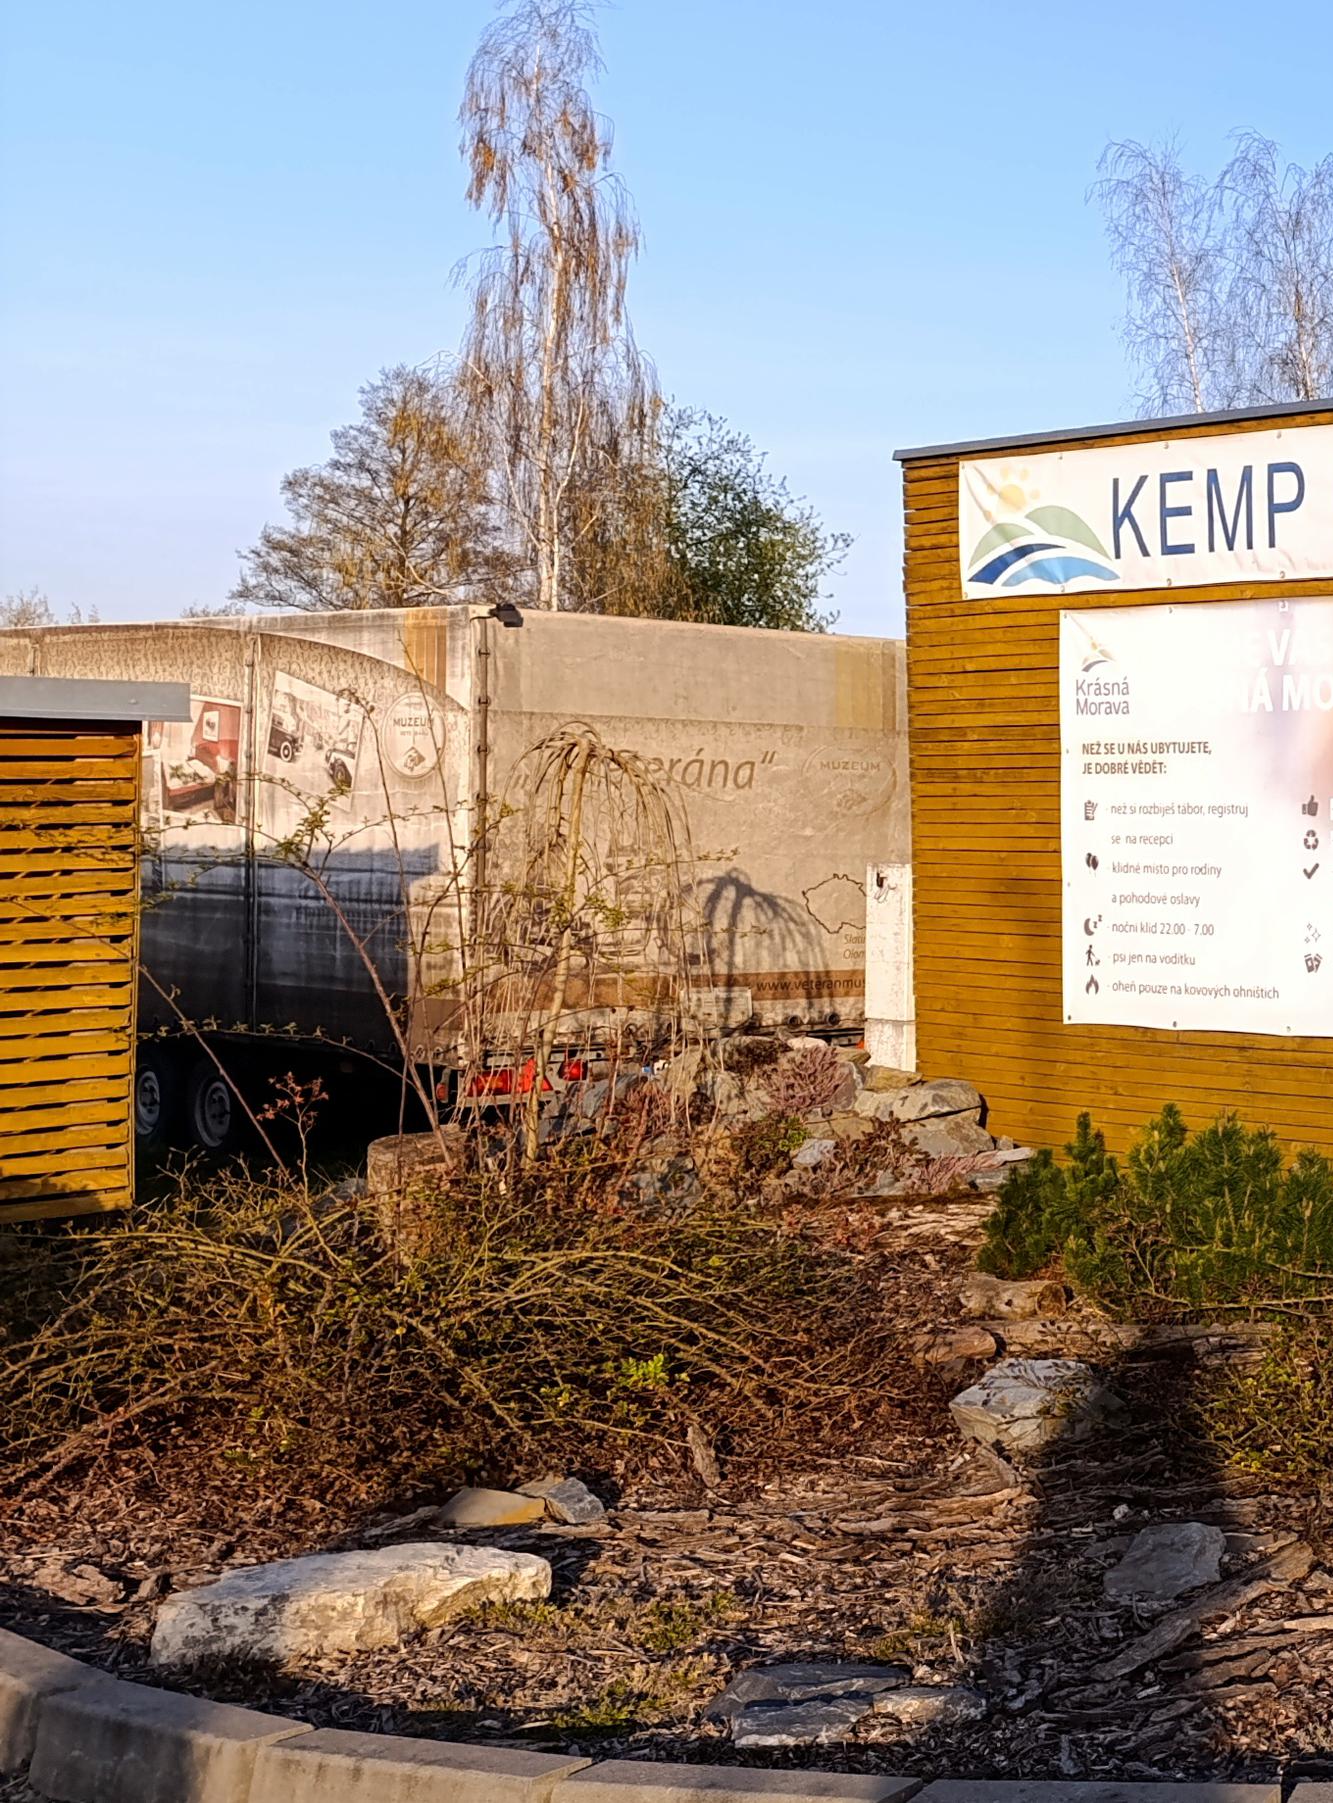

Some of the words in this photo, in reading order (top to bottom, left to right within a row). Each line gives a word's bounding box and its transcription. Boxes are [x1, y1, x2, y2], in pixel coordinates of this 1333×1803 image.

[1111, 461, 1306, 560] KEMP
[1076, 675, 1130, 697] Krásná
[1076, 698, 1130, 715] Morava
[1082, 741, 1102, 755] NEŽ
[1104, 742, 1116, 755] SE
[1117, 742, 1125, 755] U
[1127, 740, 1148, 755] NÁS
[1150, 741, 1212, 755] UBYTUJETE,
[820, 760, 882, 773] MUZEUM
[1082, 762, 1093, 774] JE
[1095, 760, 1129, 774] DOBRÉ
[1131, 760, 1167, 774] VĚDĚT:
[1110, 803, 1127, 815] než
[1129, 804, 1137, 815] si
[1138, 803, 1176, 817] rozbiješ
[1207, 804, 1249, 818] registruj
[1111, 835, 1121, 844] se
[1125, 835, 1137, 844] na
[1139, 833, 1174, 846] recepci
[1171, 866, 1188, 877] pro
[1190, 864, 1222, 878] rodiny
[1111, 894, 1117, 904] a
[1119, 892, 1168, 905] pohodové
[1170, 894, 1200, 907] oslavy
[1140, 922, 1157, 934] klid
[1160, 923, 1186, 935] 22.00
[1194, 923, 1215, 936] 7.00
[1128, 952, 1143, 965] jen
[1145, 954, 1157, 964] na
[1138, 983, 1168, 995] pouze
[1170, 985, 1182, 995] na
[1184, 984, 1231, 999] kovových
